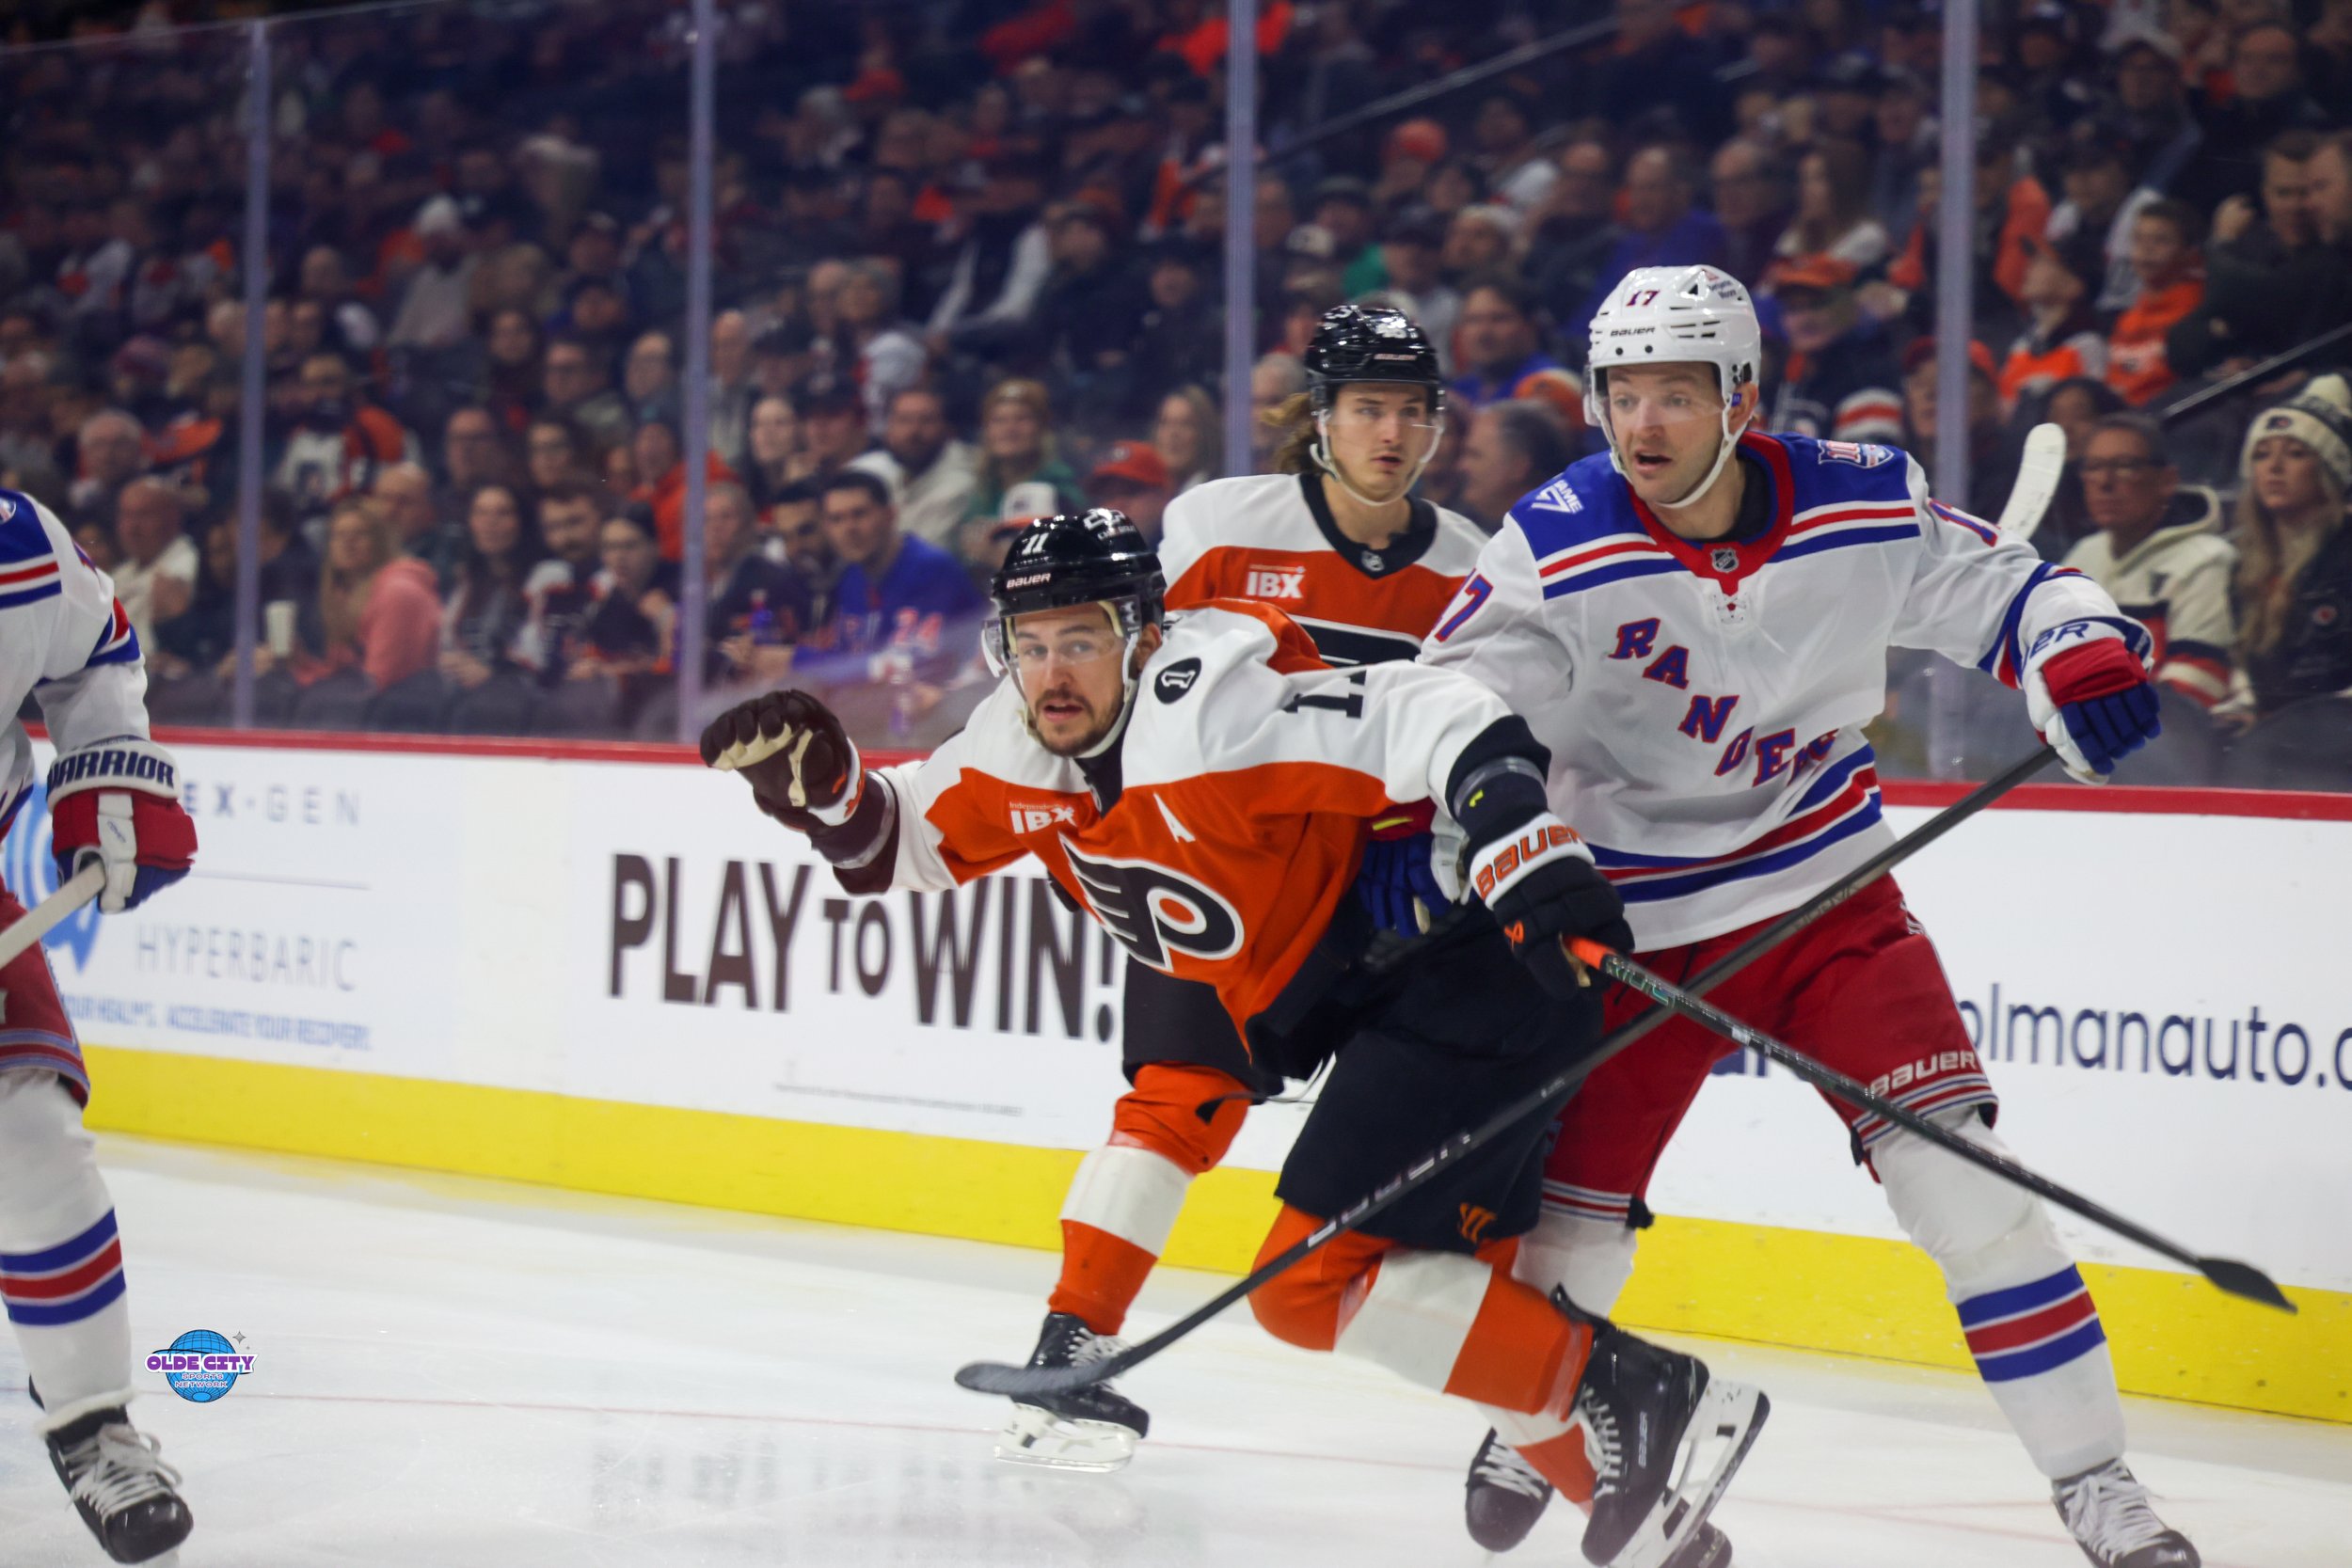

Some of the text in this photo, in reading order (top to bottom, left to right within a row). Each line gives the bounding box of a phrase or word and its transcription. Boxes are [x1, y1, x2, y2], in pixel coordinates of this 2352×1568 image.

[1626, 289, 1661, 308] 17
[1022, 532, 1049, 556] 11
[1006, 572, 1052, 590] BAUER
[1246, 571, 1305, 599] IBX
[46, 750, 175, 793] WARRIOR
[1010, 806, 1078, 834] IBX
[1152, 791, 1197, 843] A
[136, 922, 358, 991] HYPERBARIC
[608, 852, 1117, 1044] PLAY TO WIN!
[1869, 1050, 1978, 1098] BAUER
